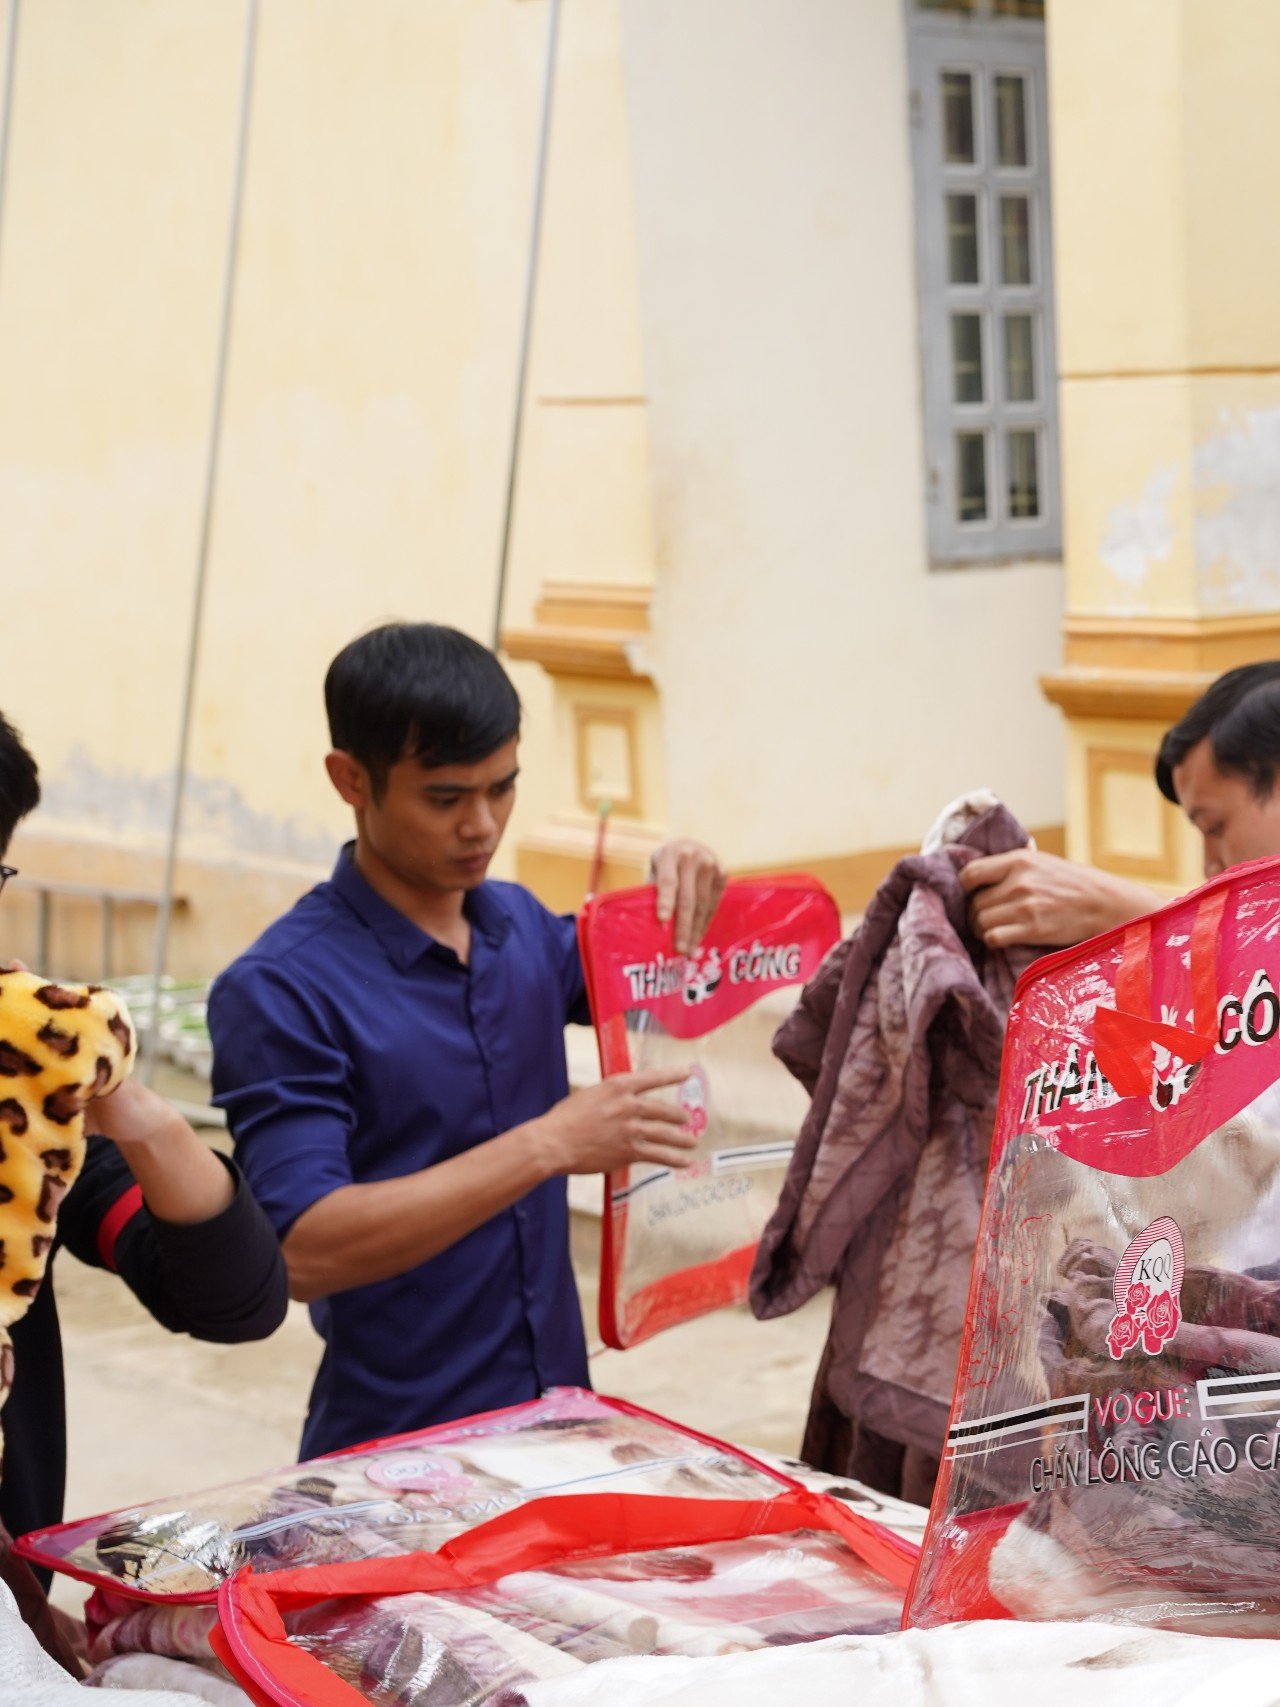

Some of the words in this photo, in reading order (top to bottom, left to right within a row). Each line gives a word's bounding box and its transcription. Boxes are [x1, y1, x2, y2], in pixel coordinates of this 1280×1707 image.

[728, 940, 800, 984] CÔNG
[1137, 1253, 1172, 1282] KQQ
[1095, 1388, 1192, 1427] VOGUE
[1029, 1443, 1080, 1493] CHĂN
[1085, 1437, 1162, 1485] LÔNG
